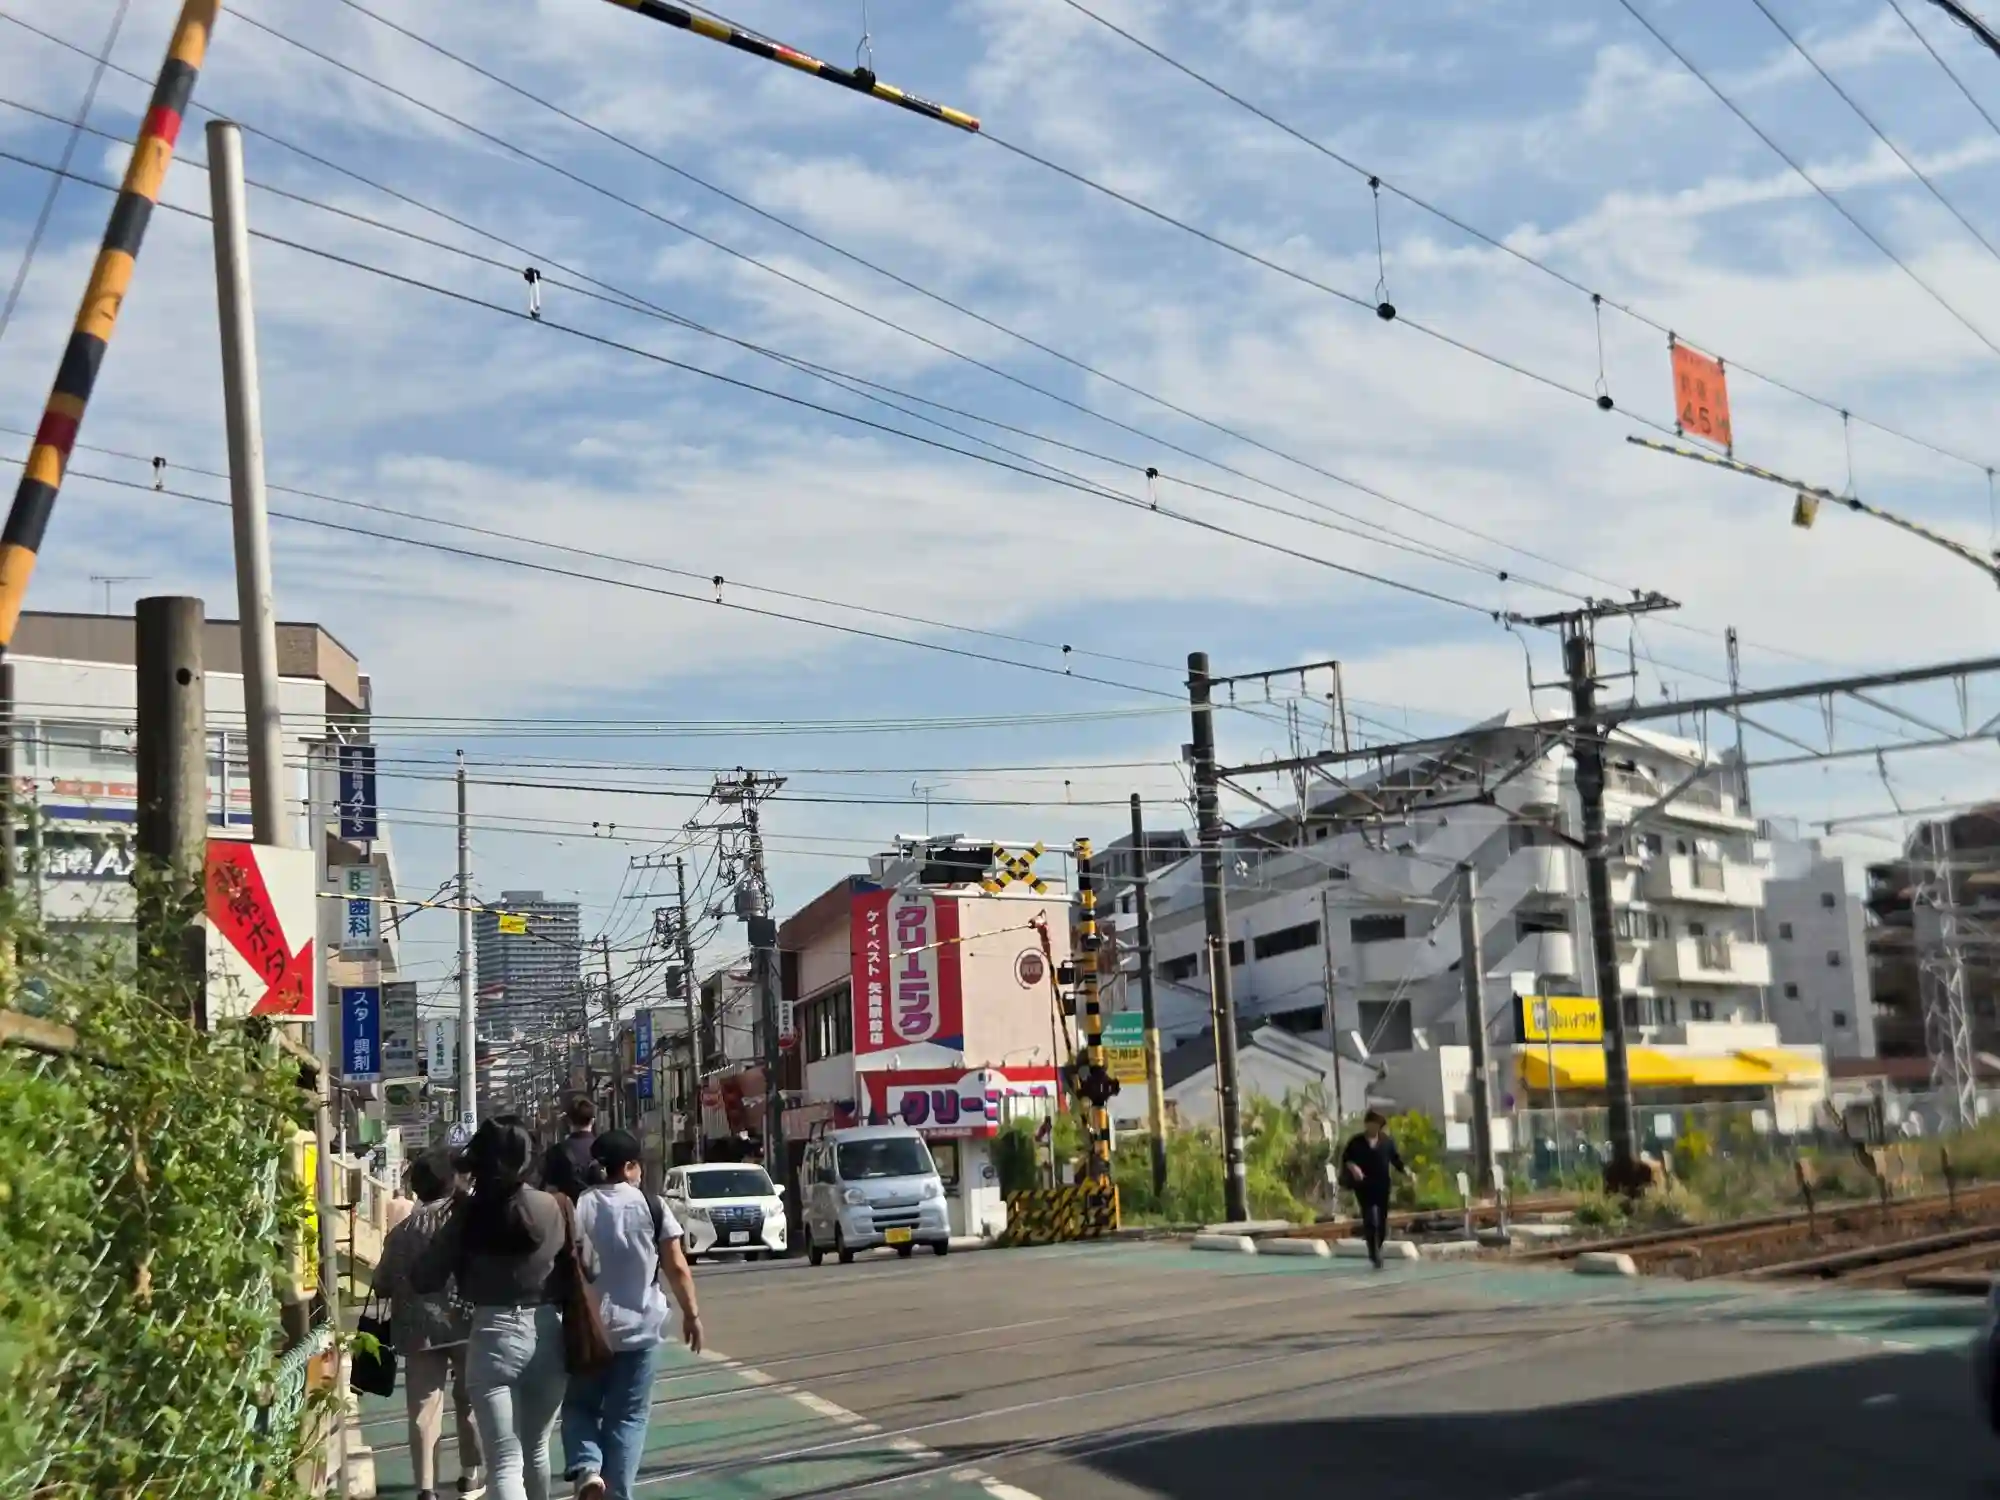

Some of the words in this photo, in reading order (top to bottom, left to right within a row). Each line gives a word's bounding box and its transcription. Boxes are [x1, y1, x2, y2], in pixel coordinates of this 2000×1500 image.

[867, 909, 881, 977] ケイベスト
[894, 905, 933, 1036] クリーニング
[353, 991, 371, 1071] スター調剤
